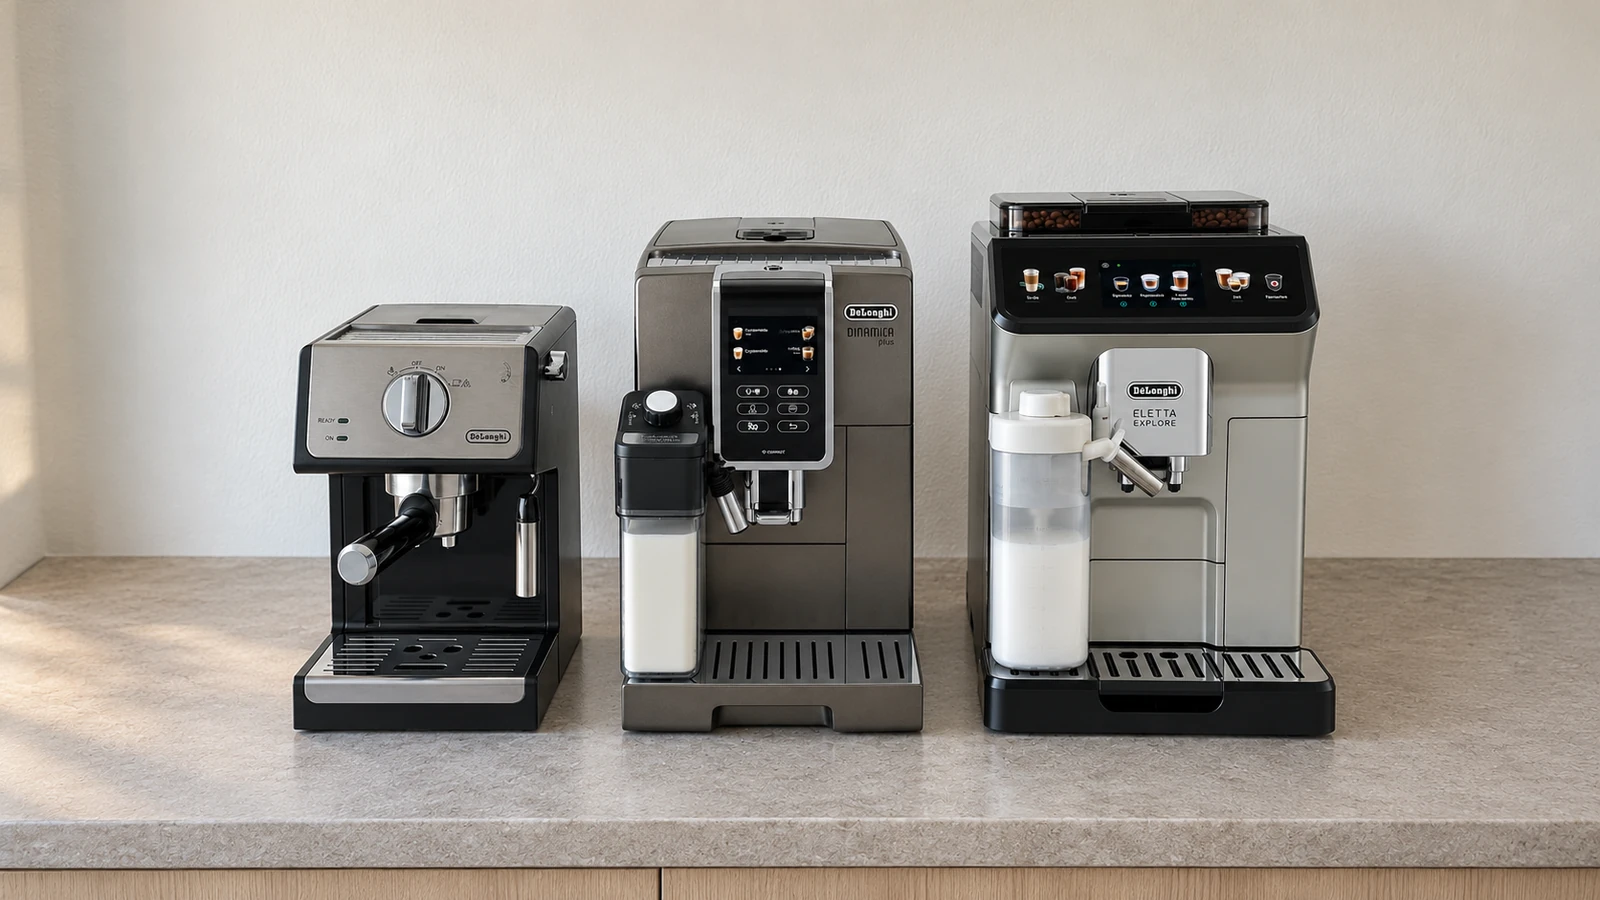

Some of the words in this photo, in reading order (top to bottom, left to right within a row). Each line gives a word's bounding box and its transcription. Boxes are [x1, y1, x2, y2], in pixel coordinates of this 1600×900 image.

[847, 327, 894, 338] DINAMICA
[878, 339, 895, 347] plus
[1133, 386, 1178, 397] DeLonghi
[1133, 408, 1177, 418] ELETTA
[1133, 419, 1177, 427] EXPLORE
